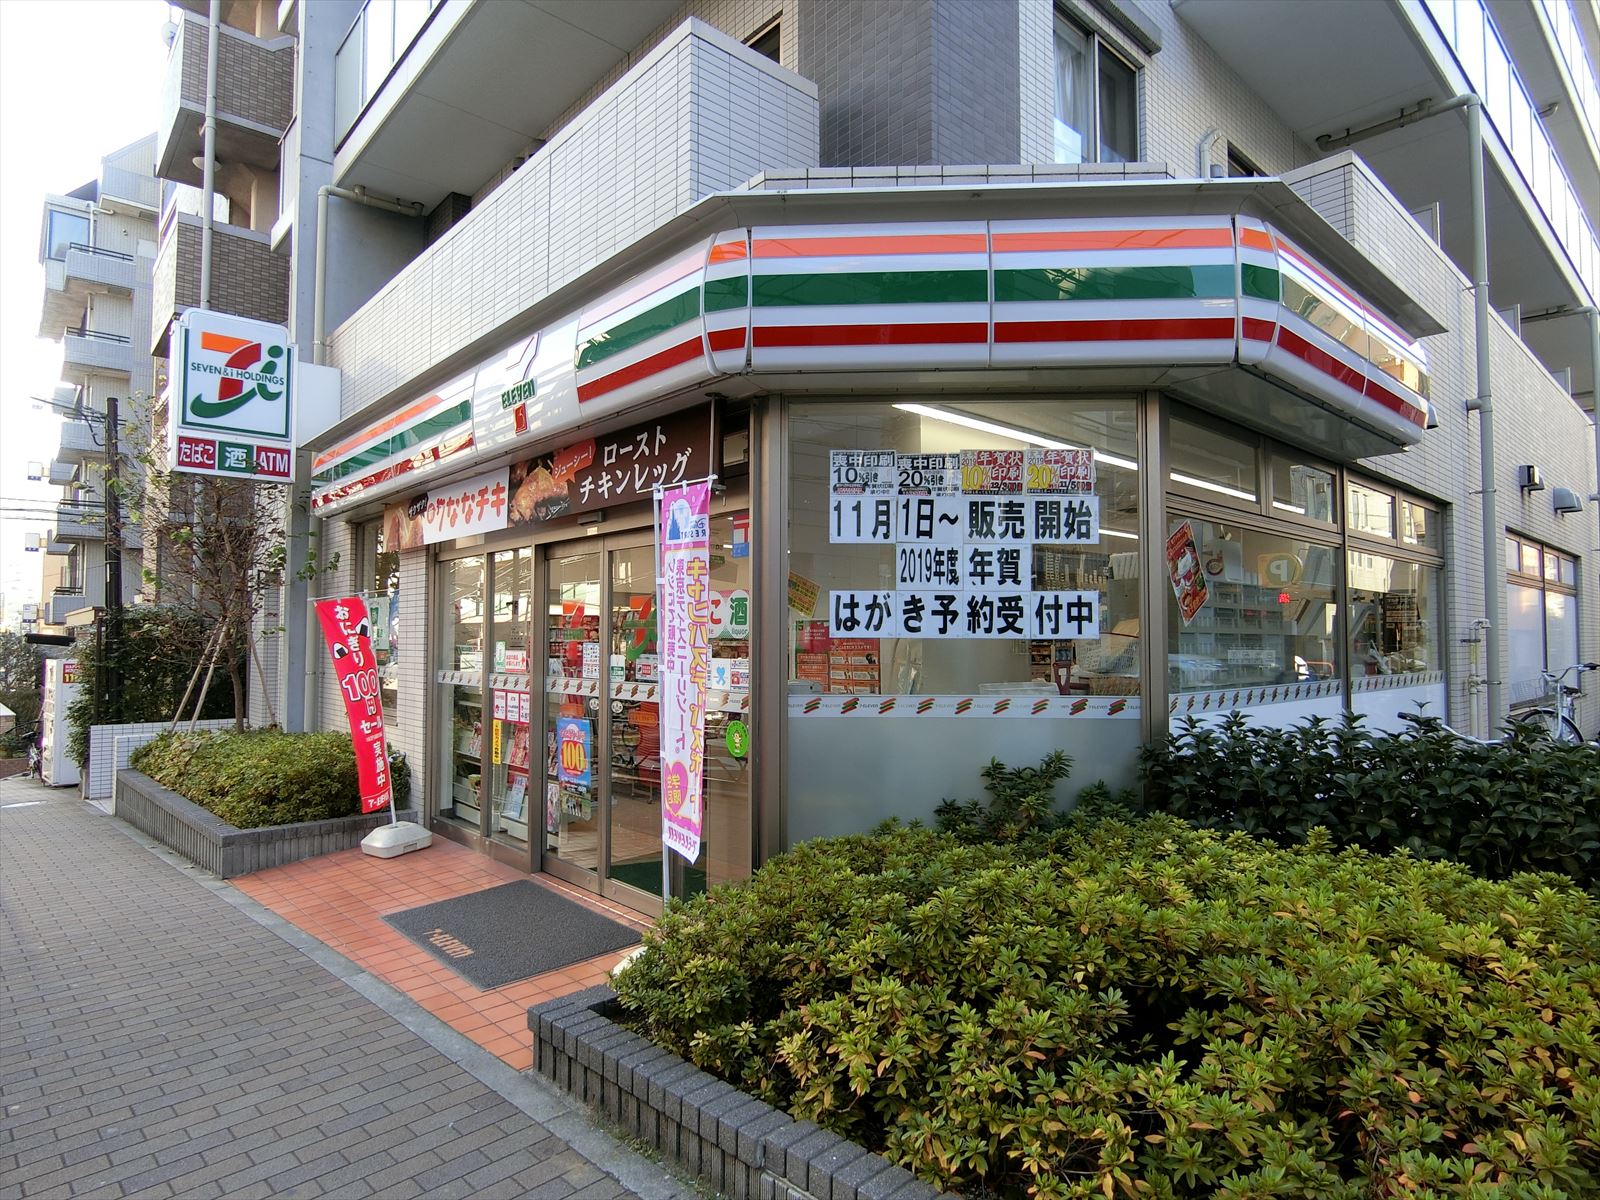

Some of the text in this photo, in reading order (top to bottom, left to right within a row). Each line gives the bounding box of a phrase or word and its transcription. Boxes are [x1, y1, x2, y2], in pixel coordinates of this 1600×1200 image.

[190, 361, 285, 386] SEVEN&i HOLDINGS
[179, 441, 289, 473] たばこ 酒 ATM
[603, 425, 667, 467] ロースト
[961, 450, 1024, 466] 2019 年賀状
[1028, 450, 1090, 466] 2019 年賀状
[833, 453, 895, 468] 喪中印刷
[897, 456, 959, 471] 喪中印刷
[580, 447, 693, 505] チキンレッグ
[833, 467, 879, 484] 10%引き
[898, 470, 945, 487] 20%引き
[961, 463, 1022, 490] 10% 印刷
[1026, 463, 1091, 489] 20% 印刷
[729, 596, 748, 626] 酒
[834, 592, 1093, 636] はがき予約受付中
[334, 605, 365, 667] おにぎり
